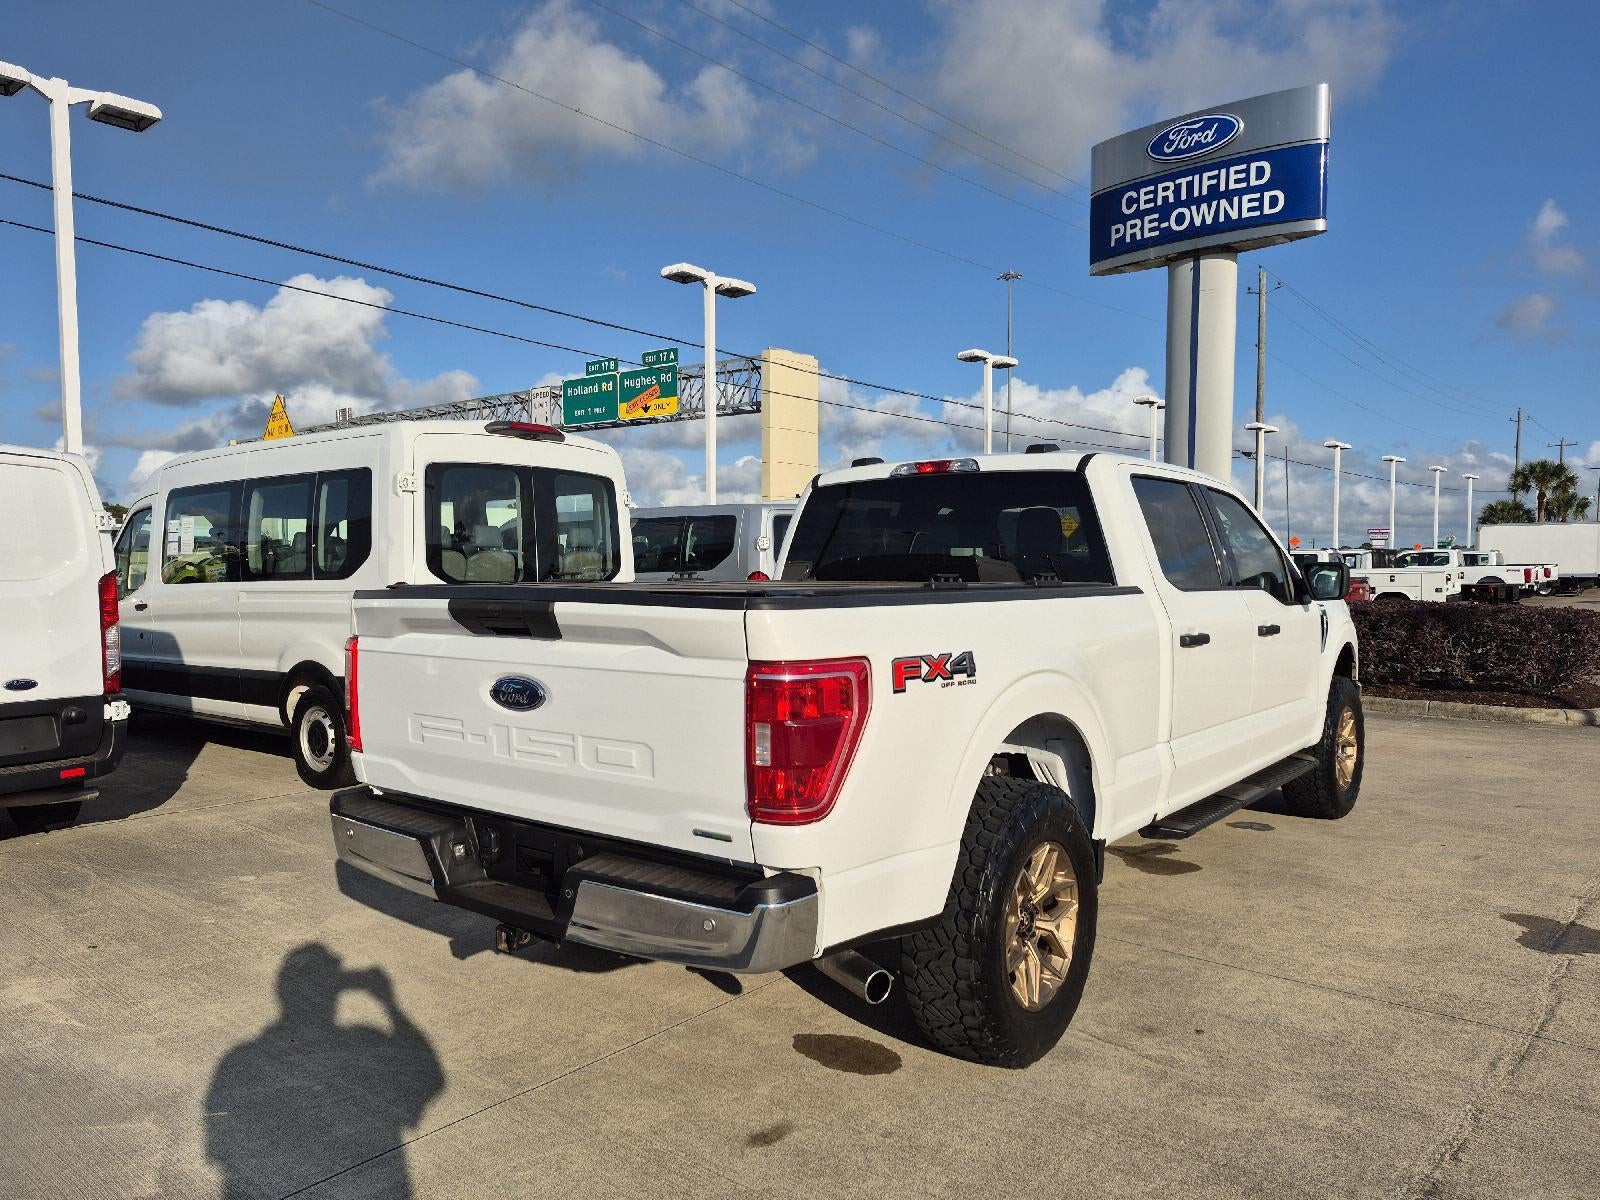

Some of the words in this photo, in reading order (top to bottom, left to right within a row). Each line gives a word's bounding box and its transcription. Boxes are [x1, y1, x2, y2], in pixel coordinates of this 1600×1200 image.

[1163, 120, 1219, 154] Ford
[1121, 160, 1272, 215] CERTIFIED
[1110, 189, 1285, 248] PRE-OWNED
[645, 355, 657, 363] EXIT
[659, 352, 667, 362] 17
[669, 351, 675, 360] A
[588, 364, 600, 372] EXIT
[601, 361, 609, 371] 17
[624, 375, 657, 389] Hughes
[660, 372, 672, 383] Rd
[532, 391, 550, 400] SPEED
[567, 383, 599, 397] Holland
[601, 381, 613, 392] Rd
[533, 401, 548, 410] LIMT
[574, 409, 585, 417] EXIT
[593, 407, 606, 415] MILE
[653, 402, 671, 411] ONLY
[891, 650, 977, 695] FX4
[957, 679, 977, 687] ROAD
[407, 712, 656, 780] F-150
